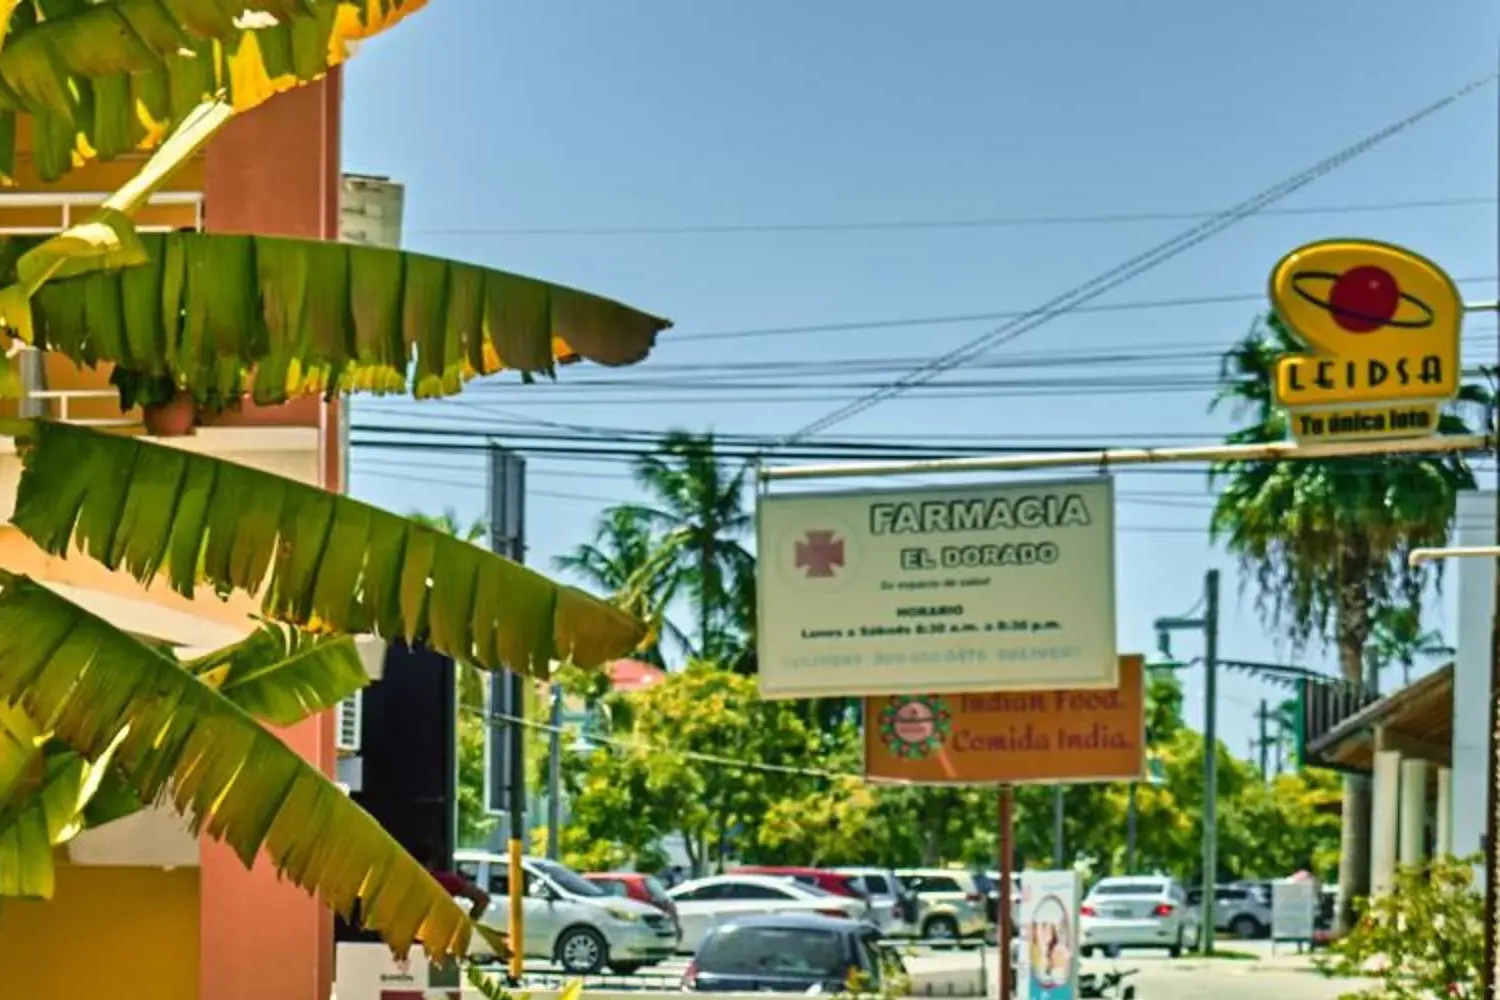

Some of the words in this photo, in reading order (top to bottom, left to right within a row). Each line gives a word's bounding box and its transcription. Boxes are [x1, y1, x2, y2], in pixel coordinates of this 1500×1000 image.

[1289, 355, 1442, 390] LEIDSA
[870, 494, 1091, 535] FARMACIA
[900, 547, 937, 571] EL
[941, 542, 1059, 569] DORADO
[897, 604, 964, 618] HORARIO
[801, 628, 843, 639] Lunes
[961, 691, 1045, 714] Indian
[953, 726, 1050, 752] Comida
[1057, 722, 1134, 750] India.
